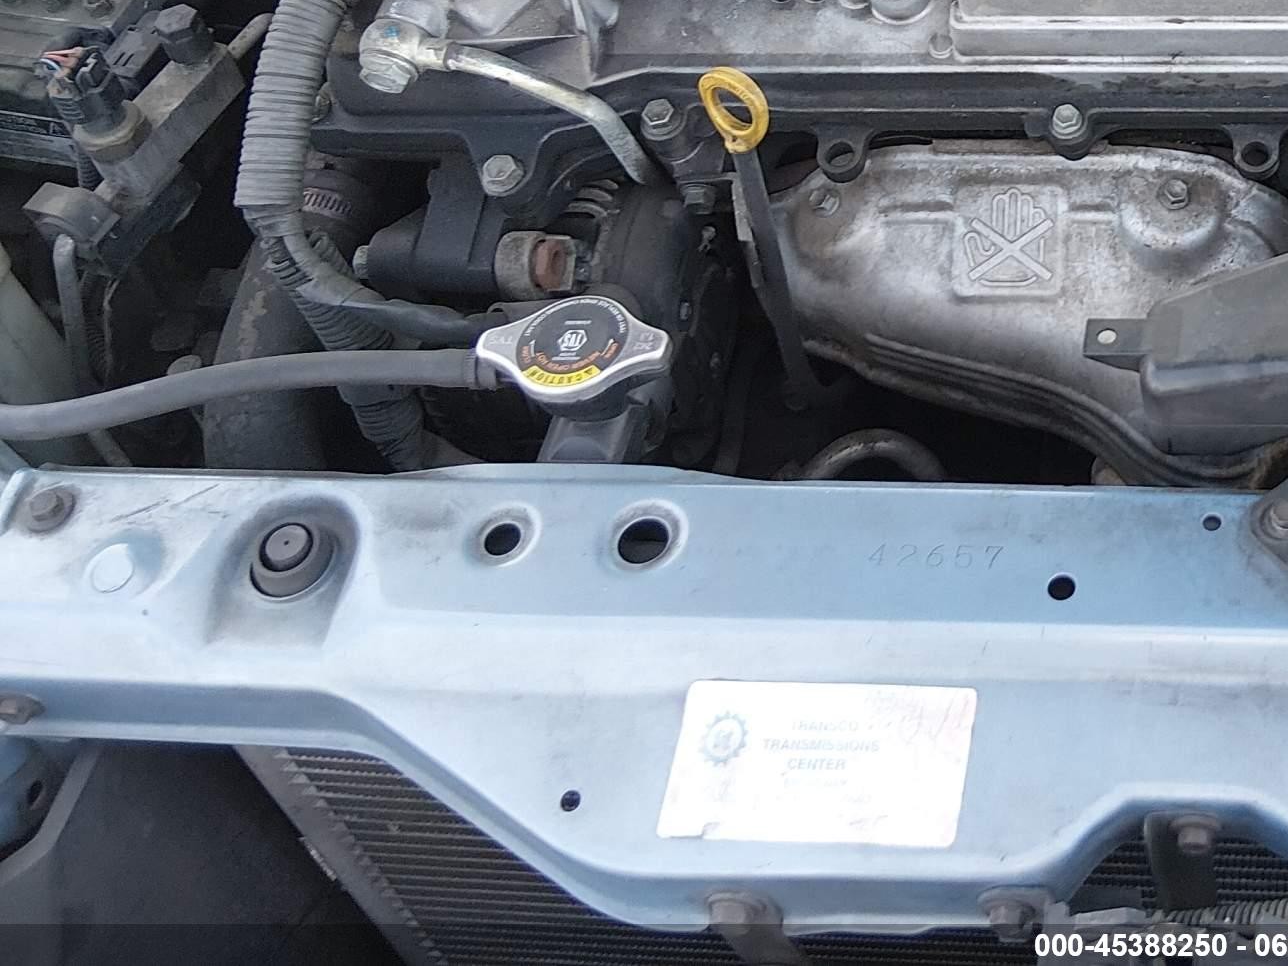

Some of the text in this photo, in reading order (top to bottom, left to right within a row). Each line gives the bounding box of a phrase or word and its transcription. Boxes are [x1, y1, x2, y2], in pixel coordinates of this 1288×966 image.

[563, 333, 585, 348] TVS
[528, 370, 583, 385] CAUTION
[867, 542, 1005, 570] 42657
[762, 738, 882, 753] TRANSMISSIONS
[786, 758, 847, 771] CENTER
